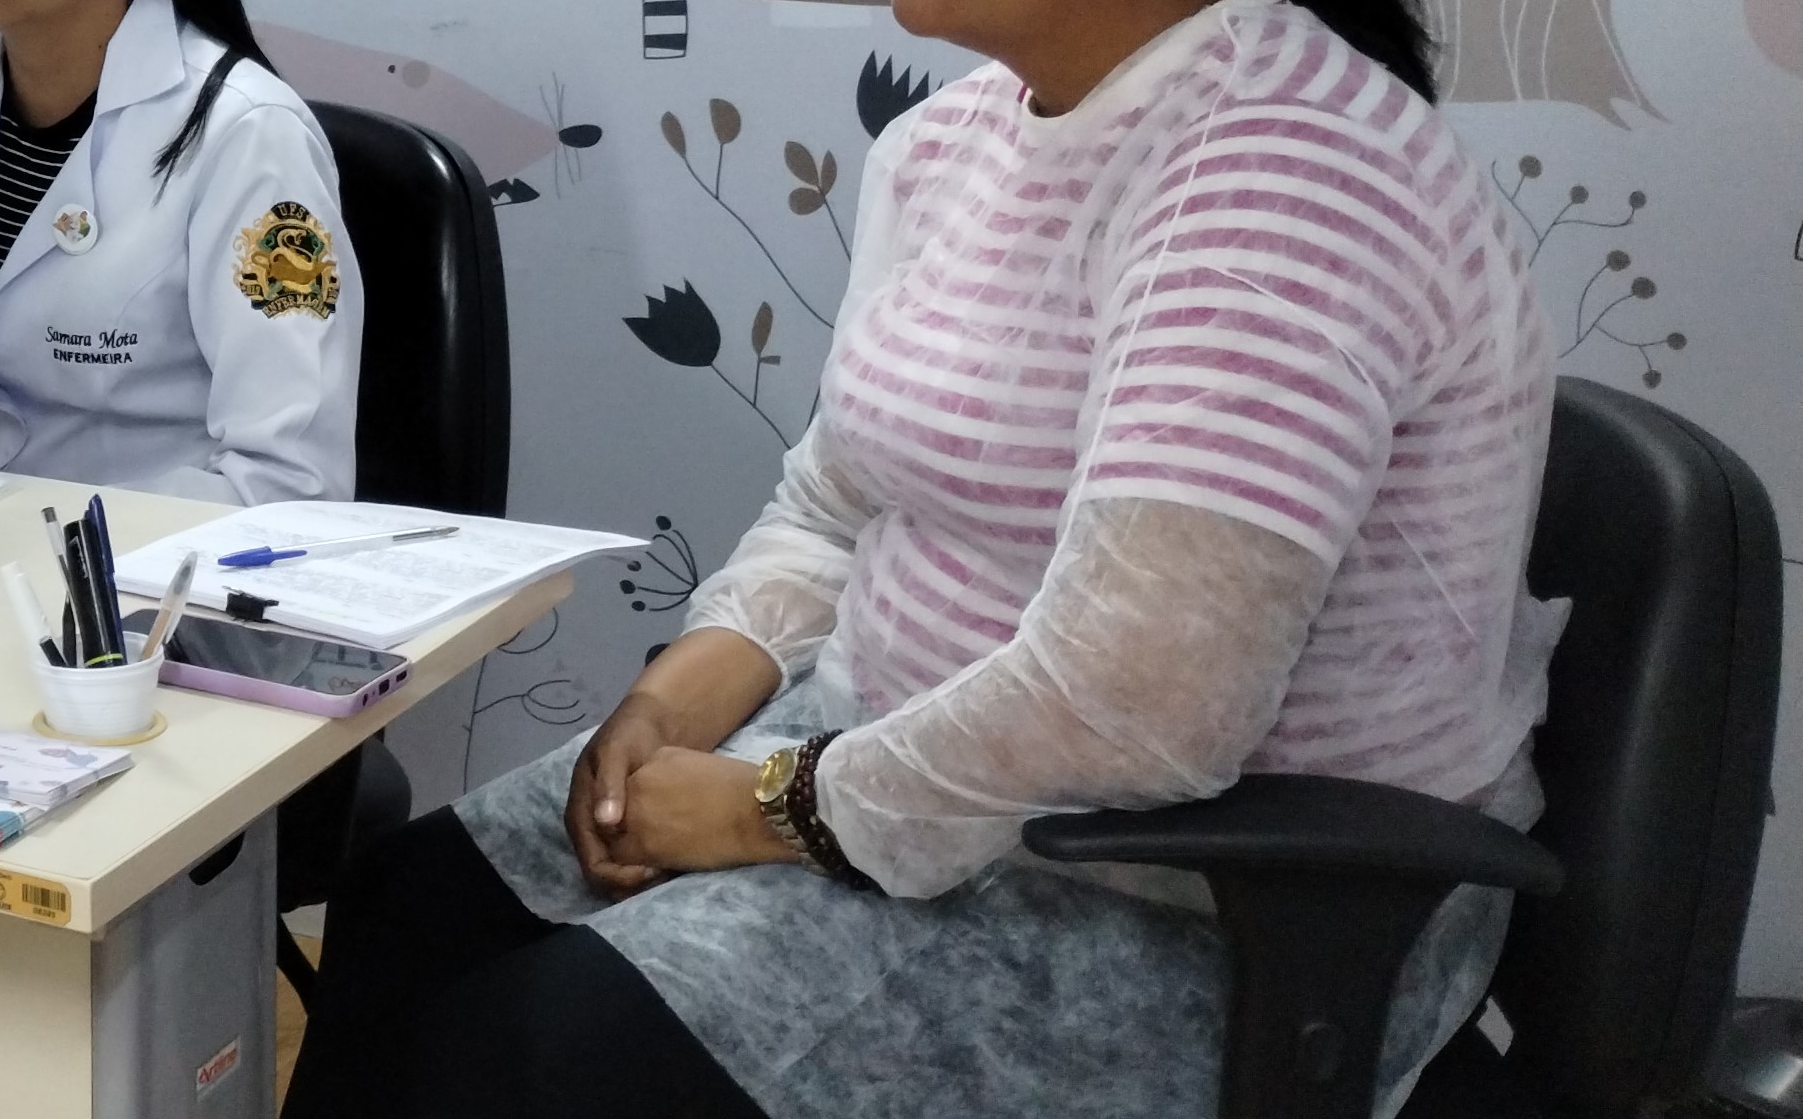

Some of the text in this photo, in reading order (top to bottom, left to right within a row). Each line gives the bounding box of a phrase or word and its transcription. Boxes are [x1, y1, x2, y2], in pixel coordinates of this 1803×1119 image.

[45, 326, 138, 349] Samara Mota
[53, 348, 133, 365] ENFERMEIRA
